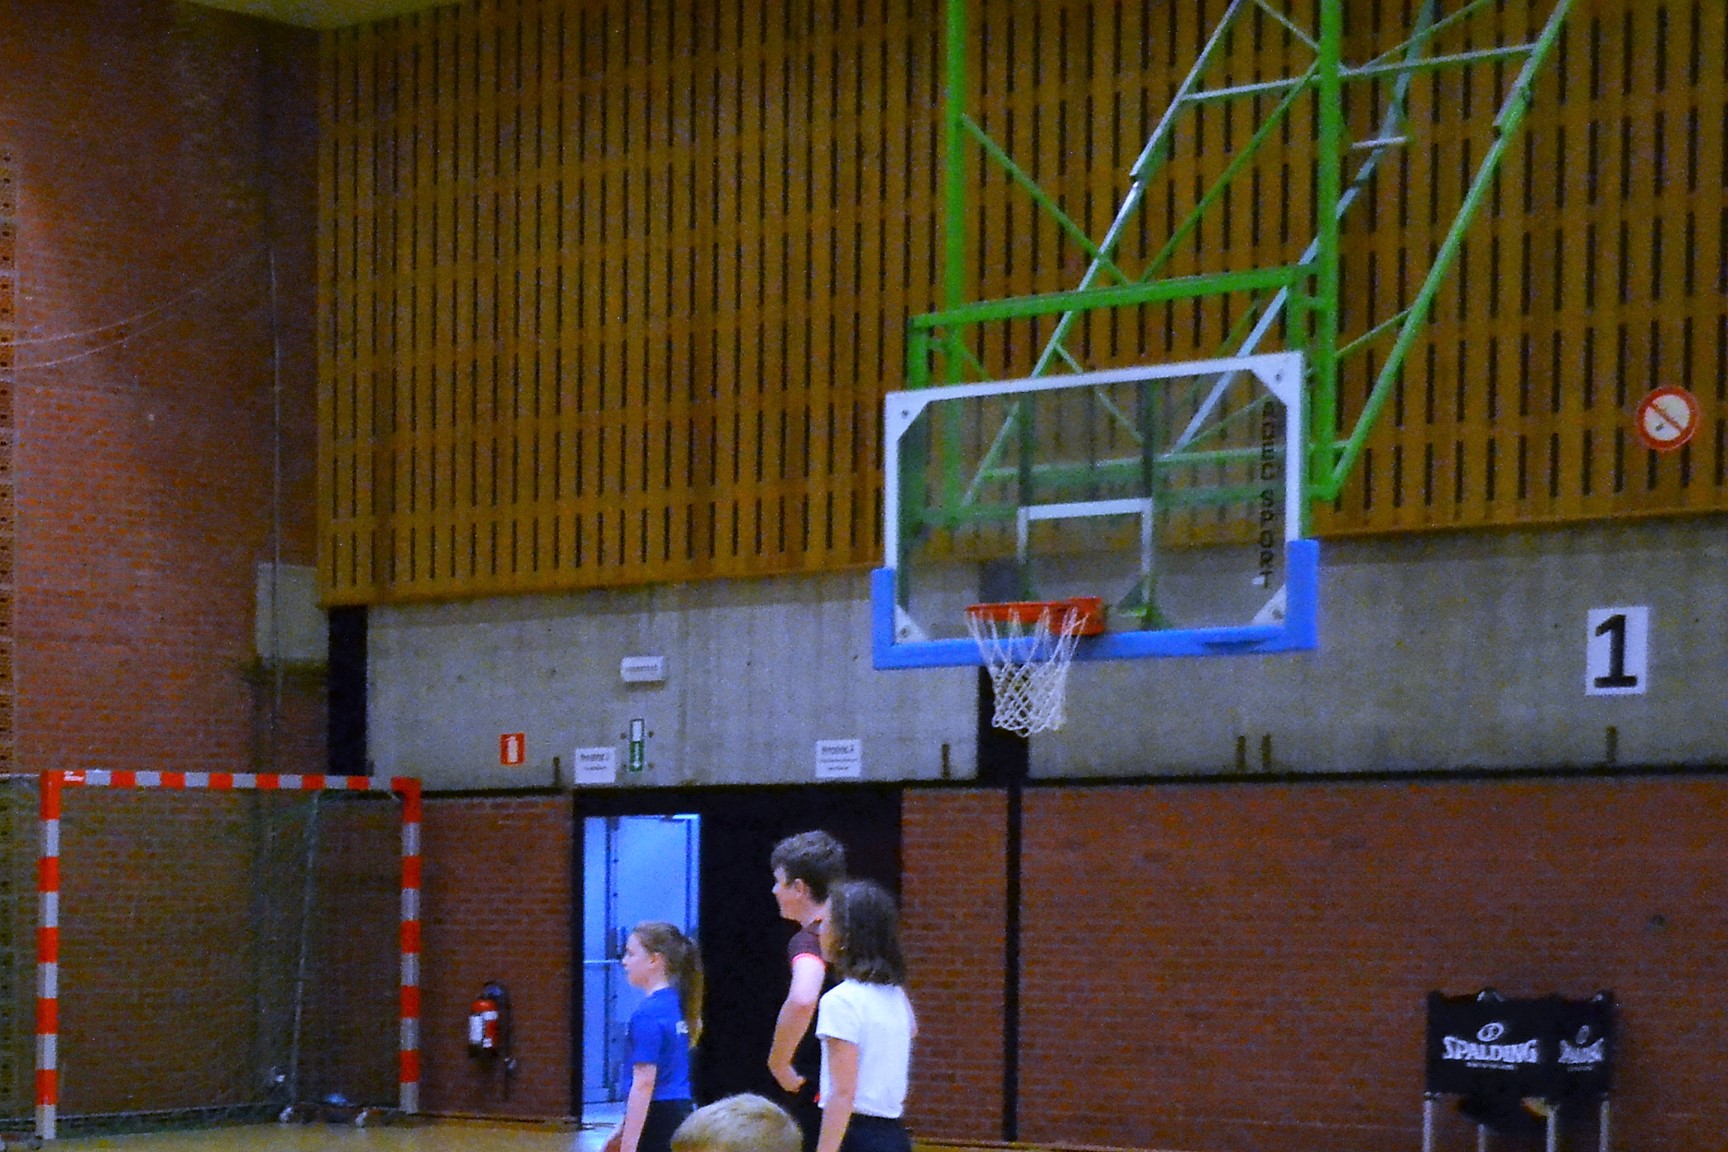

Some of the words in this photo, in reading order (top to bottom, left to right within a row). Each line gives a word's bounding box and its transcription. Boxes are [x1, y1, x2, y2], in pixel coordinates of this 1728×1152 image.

[1260, 488, 1274, 588] SPORT
[1594, 614, 1638, 688] 1
[1442, 1036, 1538, 1063] SPALDING
